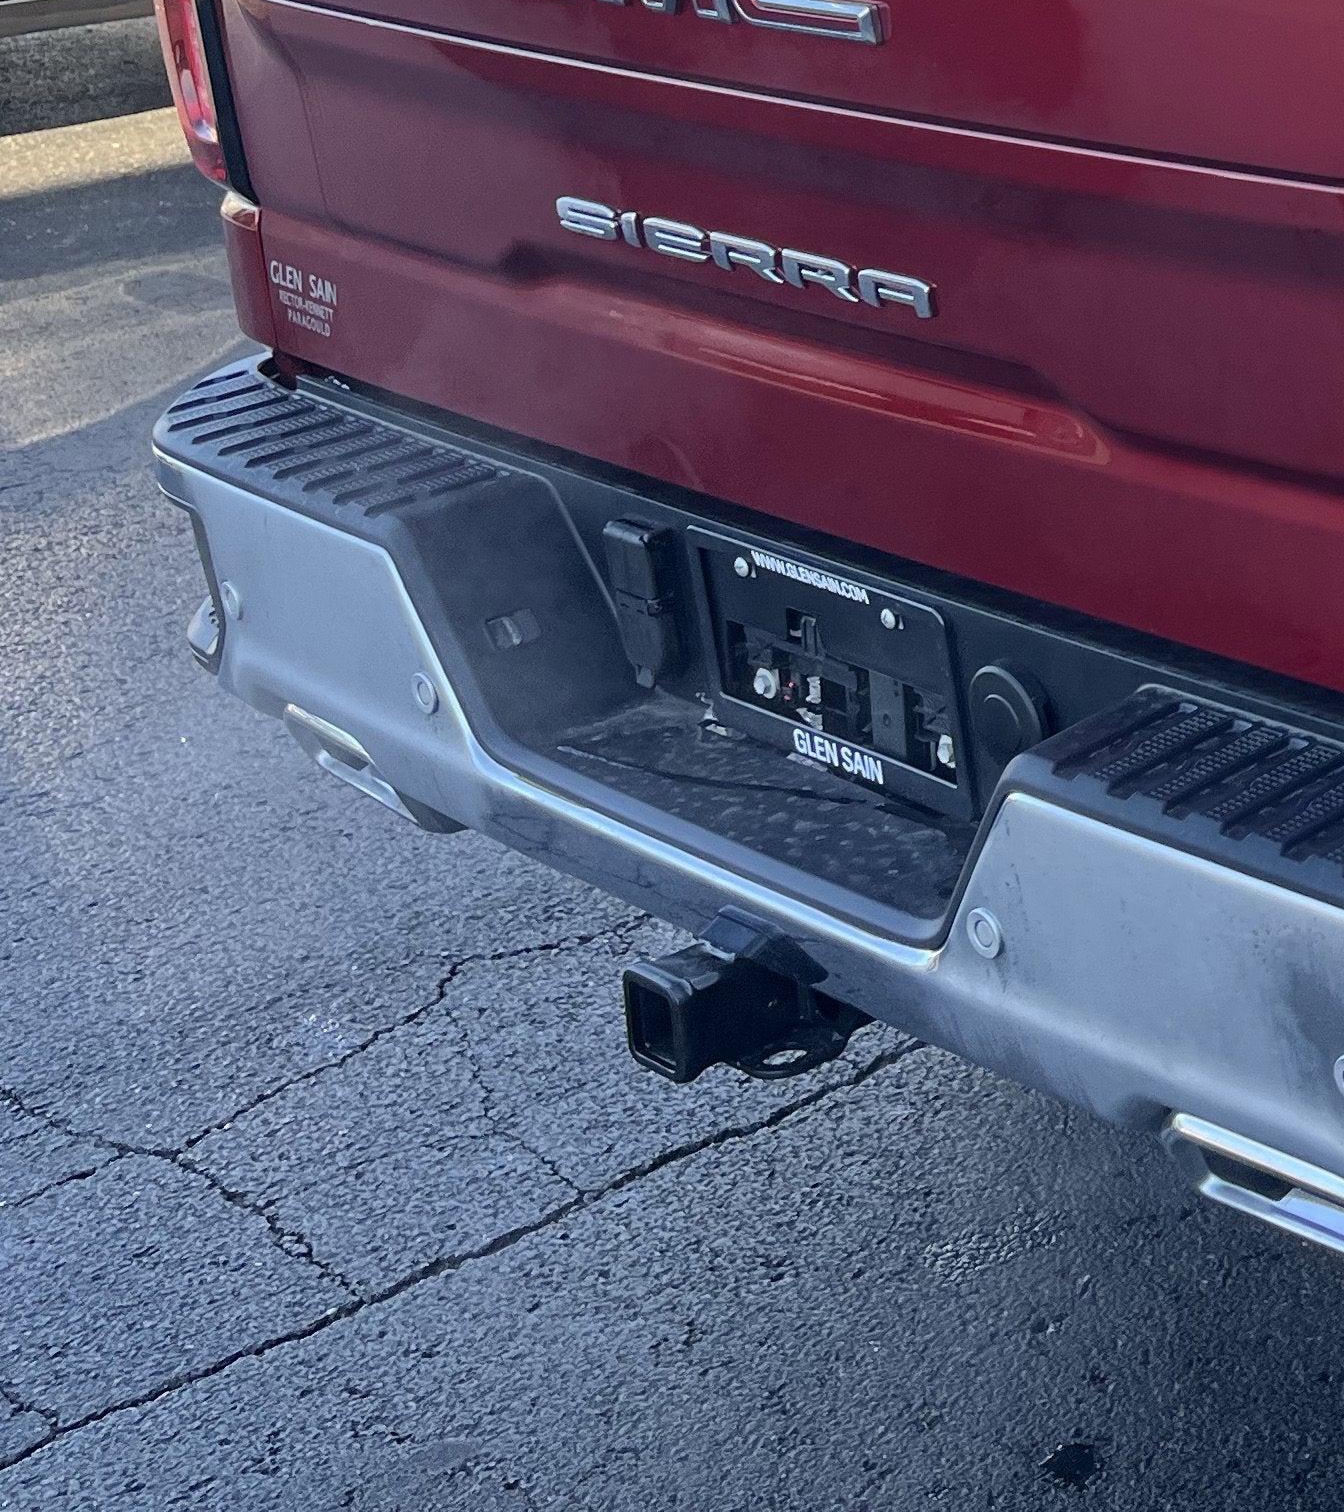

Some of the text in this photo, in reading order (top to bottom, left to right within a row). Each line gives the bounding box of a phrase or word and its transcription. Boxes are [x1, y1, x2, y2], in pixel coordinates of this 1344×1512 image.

[270, 259, 337, 306] GLEN SAIN
[556, 195, 937, 320] SIERRA
[750, 550, 870, 605] WWW.GLENSAIN.COM
[793, 728, 884, 785] GLEN SAIN
